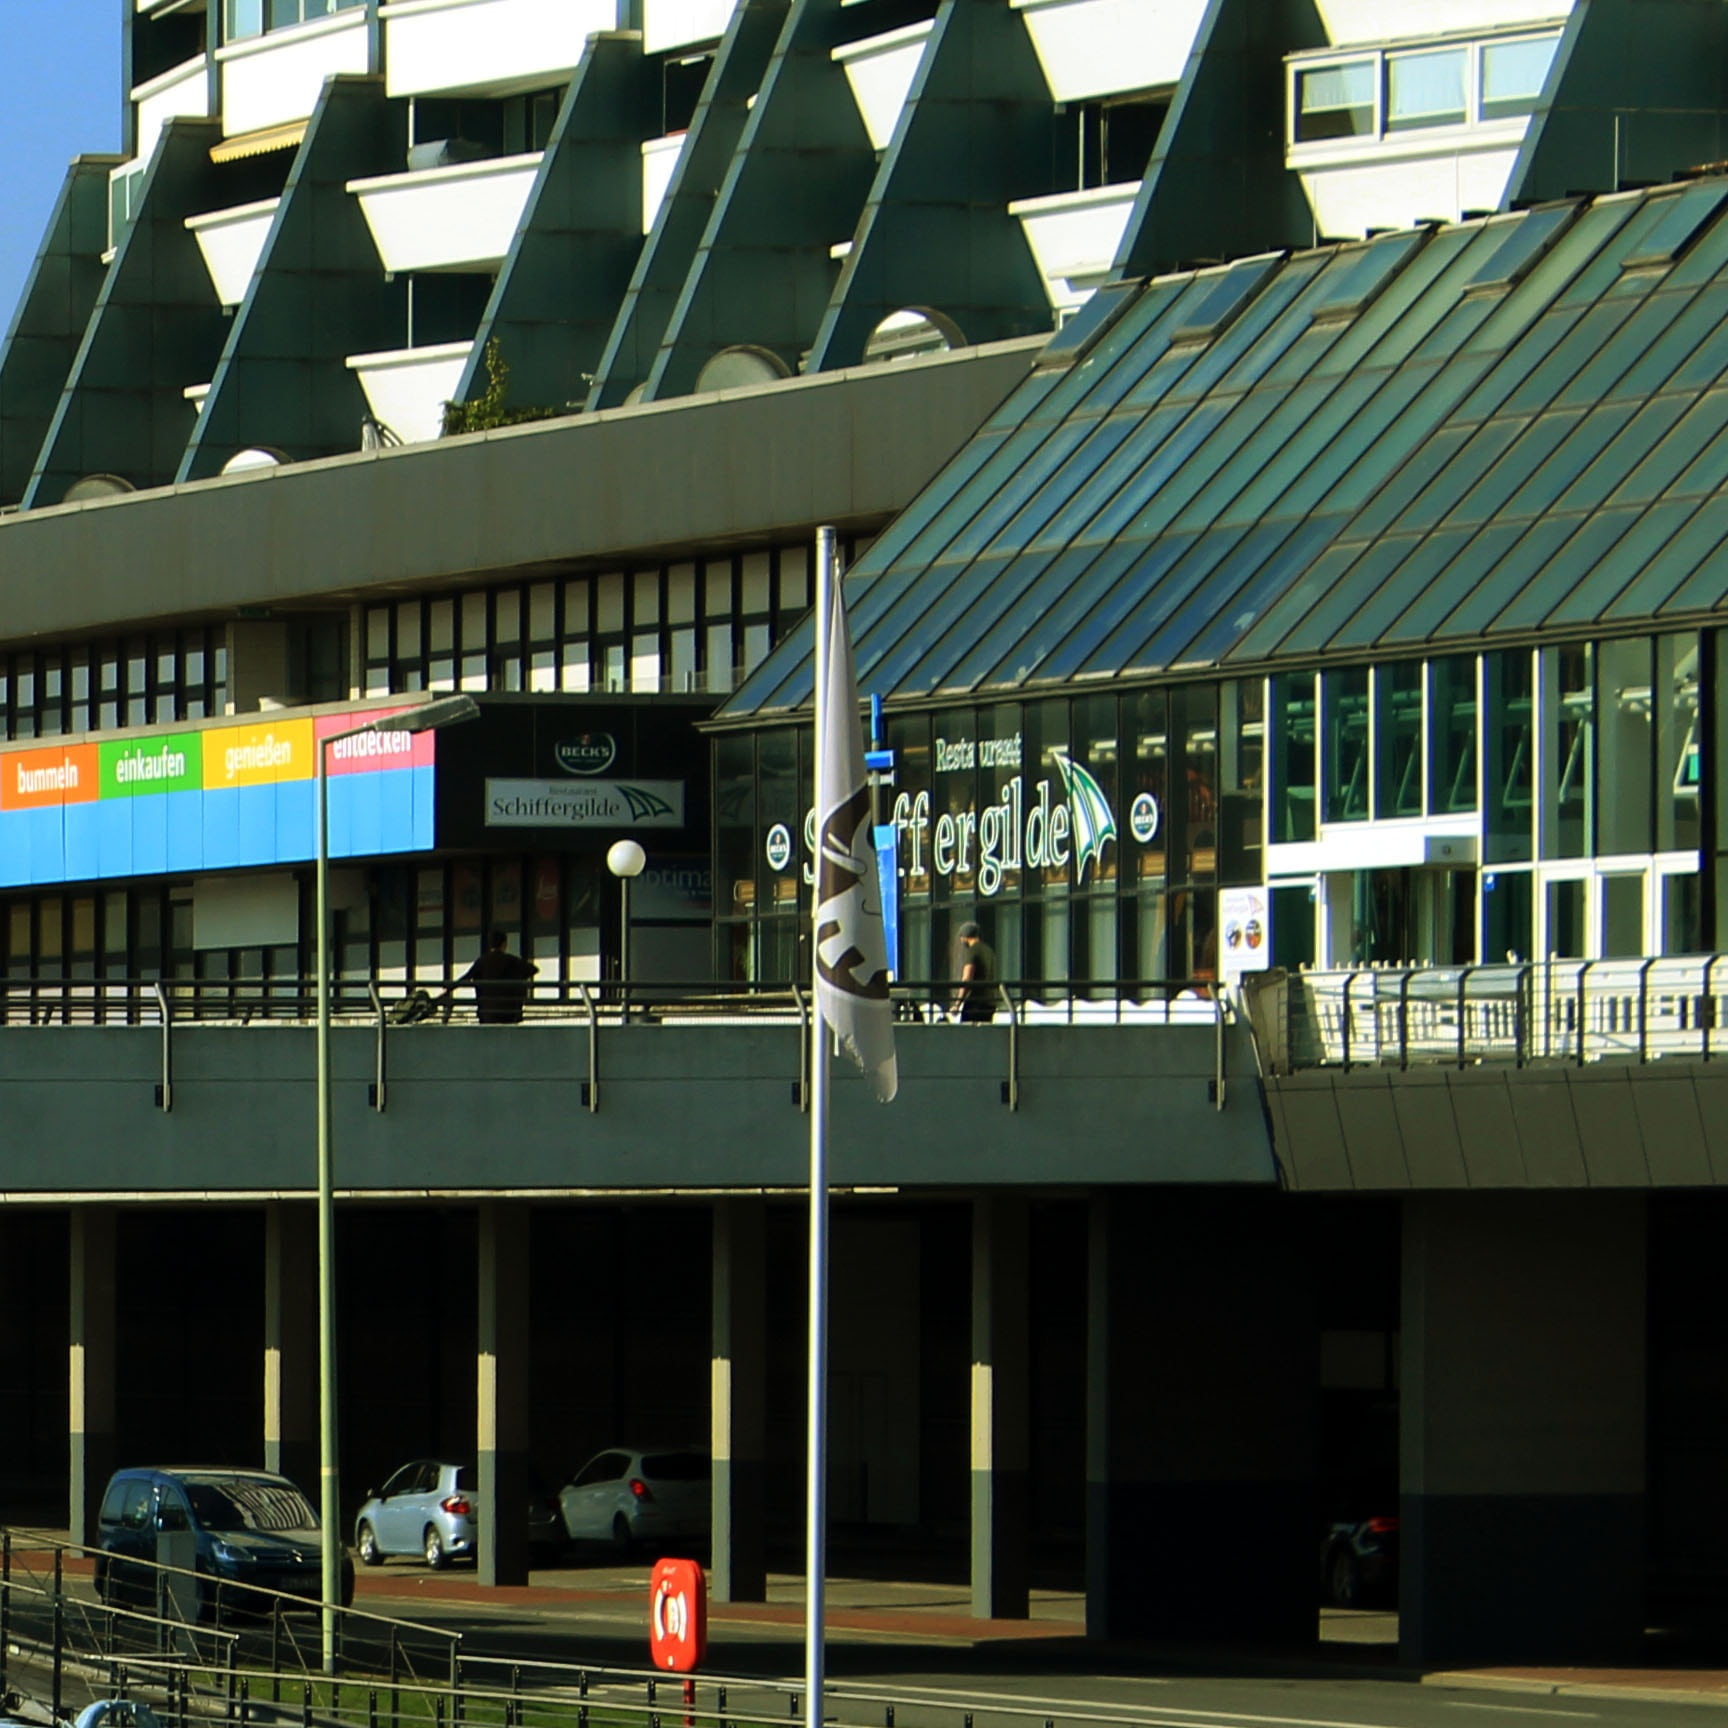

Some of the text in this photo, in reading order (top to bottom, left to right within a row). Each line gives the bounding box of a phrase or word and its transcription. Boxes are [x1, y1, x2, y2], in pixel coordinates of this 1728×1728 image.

[225, 732, 292, 779] genießen
[333, 721, 412, 759] entdecken
[17, 758, 78, 794] bummeln
[116, 745, 184, 783] einkaufen
[493, 796, 620, 821] Schiffergilde
